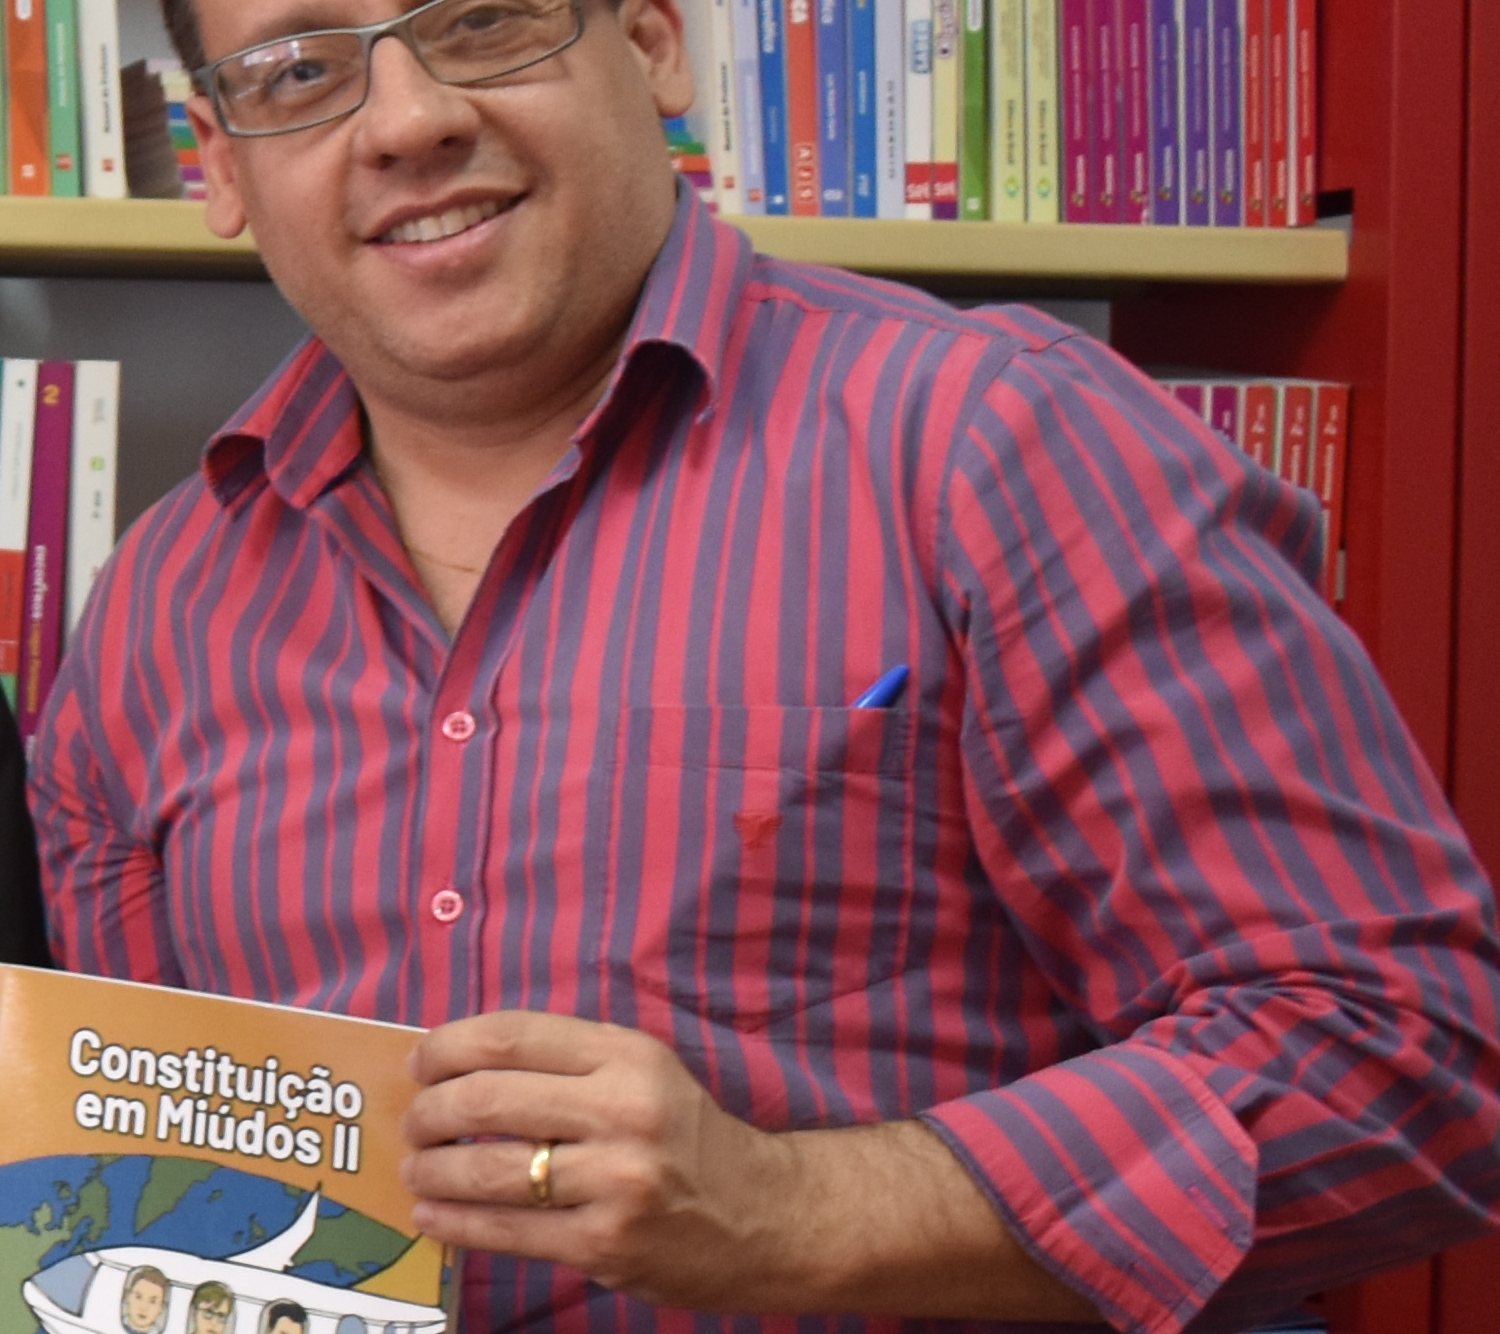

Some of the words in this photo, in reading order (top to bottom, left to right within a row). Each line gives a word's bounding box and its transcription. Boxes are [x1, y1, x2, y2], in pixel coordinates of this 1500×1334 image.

[69, 1028, 364, 1119] Constituição
[74, 1090, 146, 1137] em
[155, 1092, 322, 1167] Miúdos
[332, 1122, 361, 1174] II
